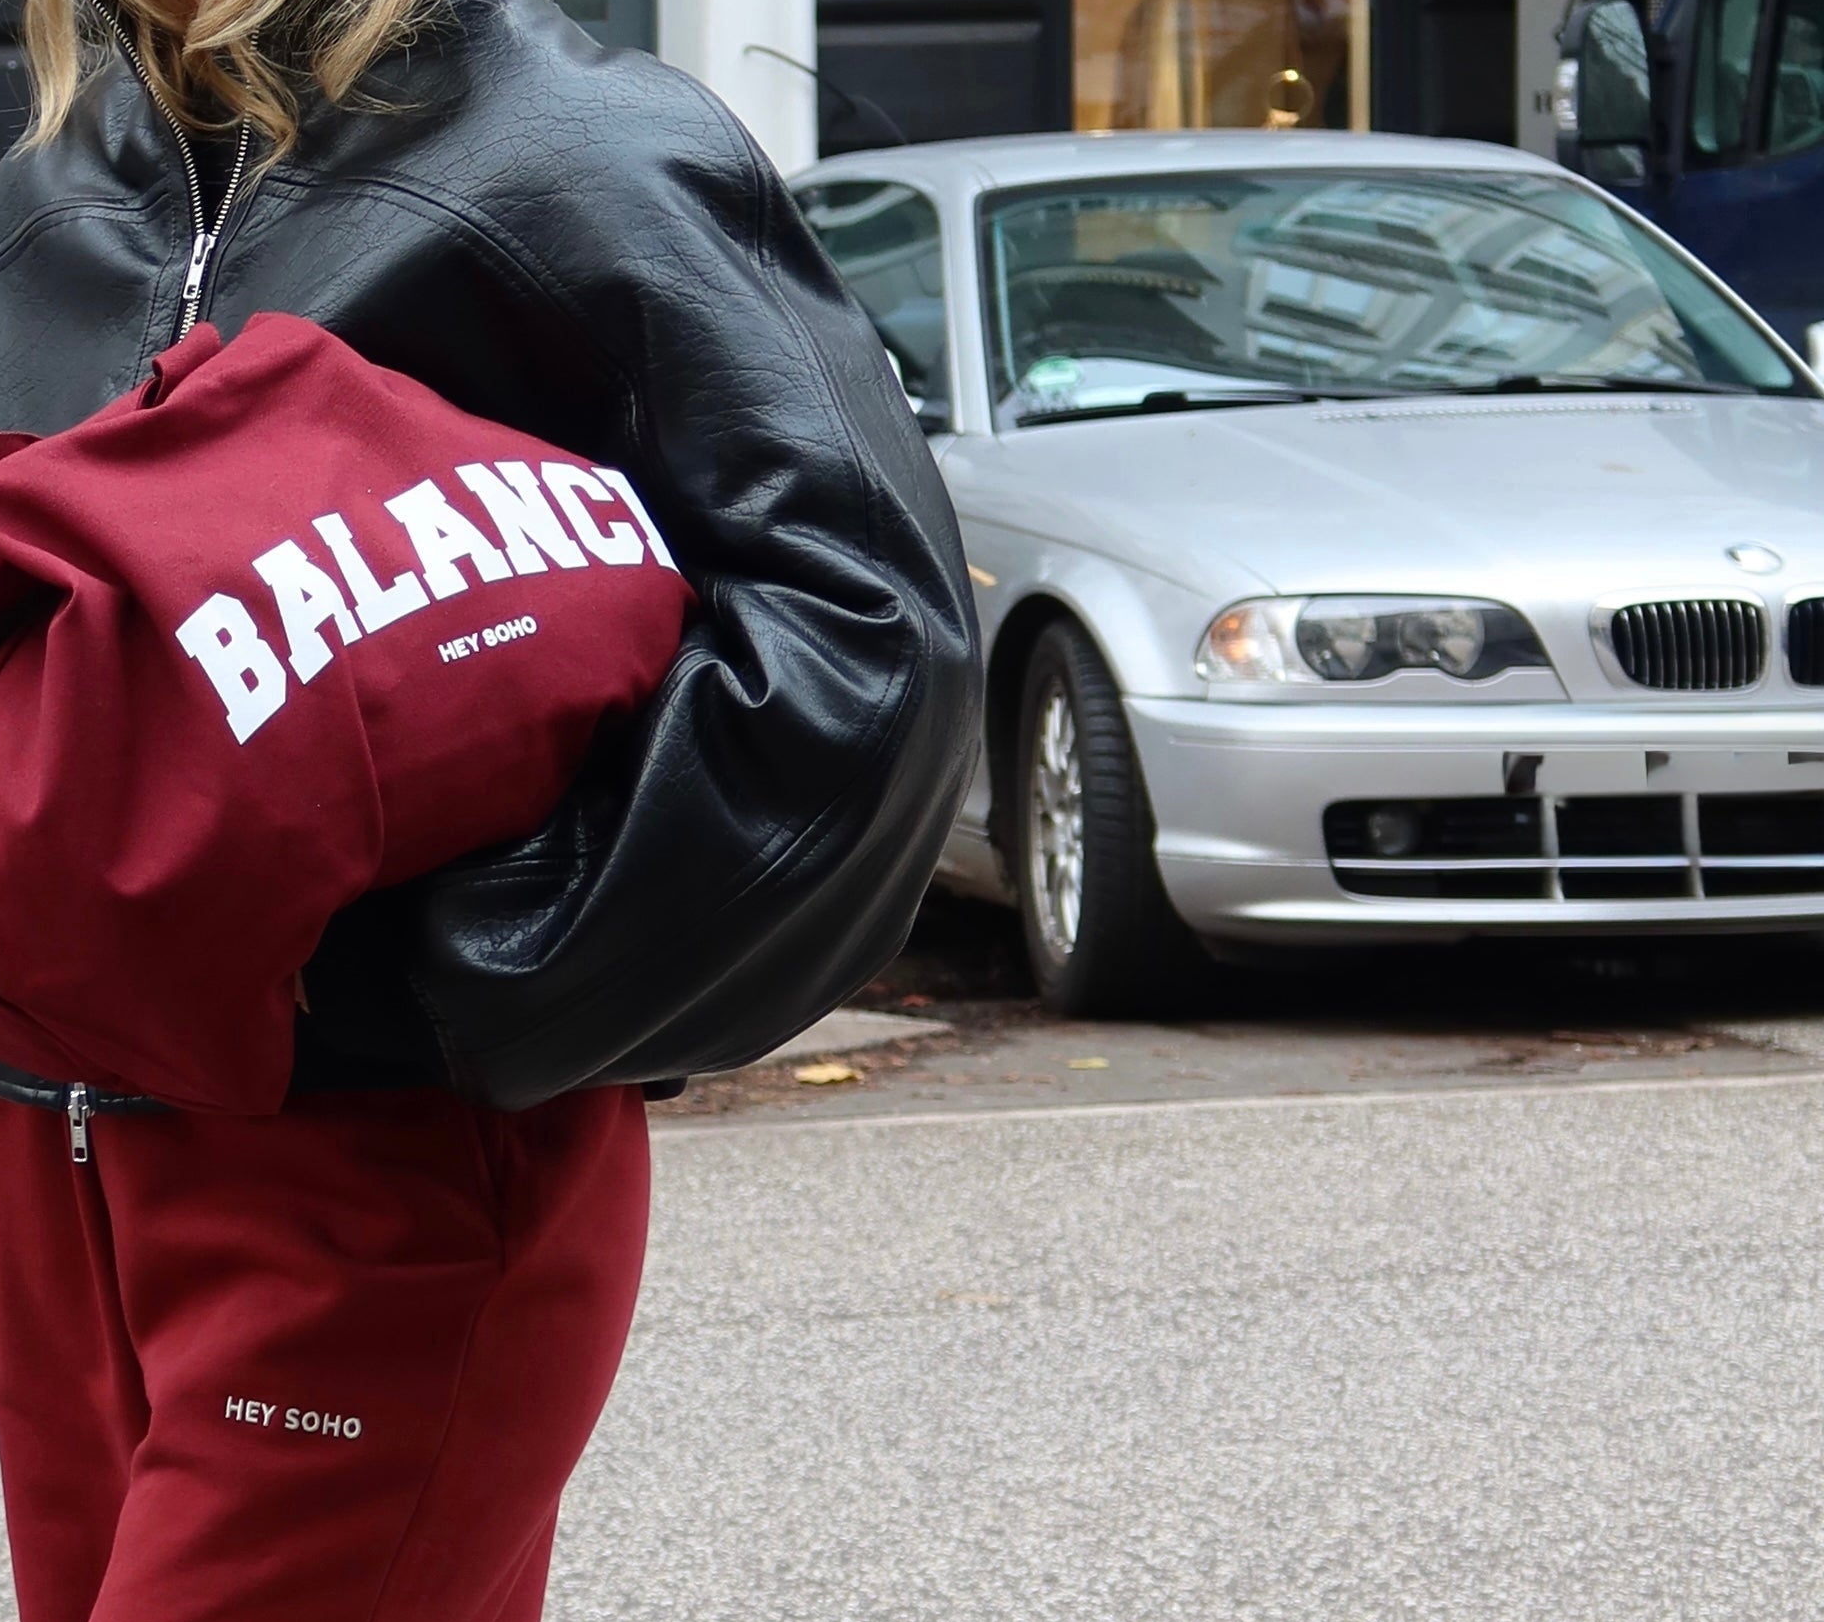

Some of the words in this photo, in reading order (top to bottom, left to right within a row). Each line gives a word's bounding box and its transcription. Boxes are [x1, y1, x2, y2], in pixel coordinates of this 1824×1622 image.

[437, 632, 480, 663] HEY
[481, 615, 537, 647] SOHO
[225, 1395, 277, 1427] HEY
[284, 1408, 362, 1439] SOHO
